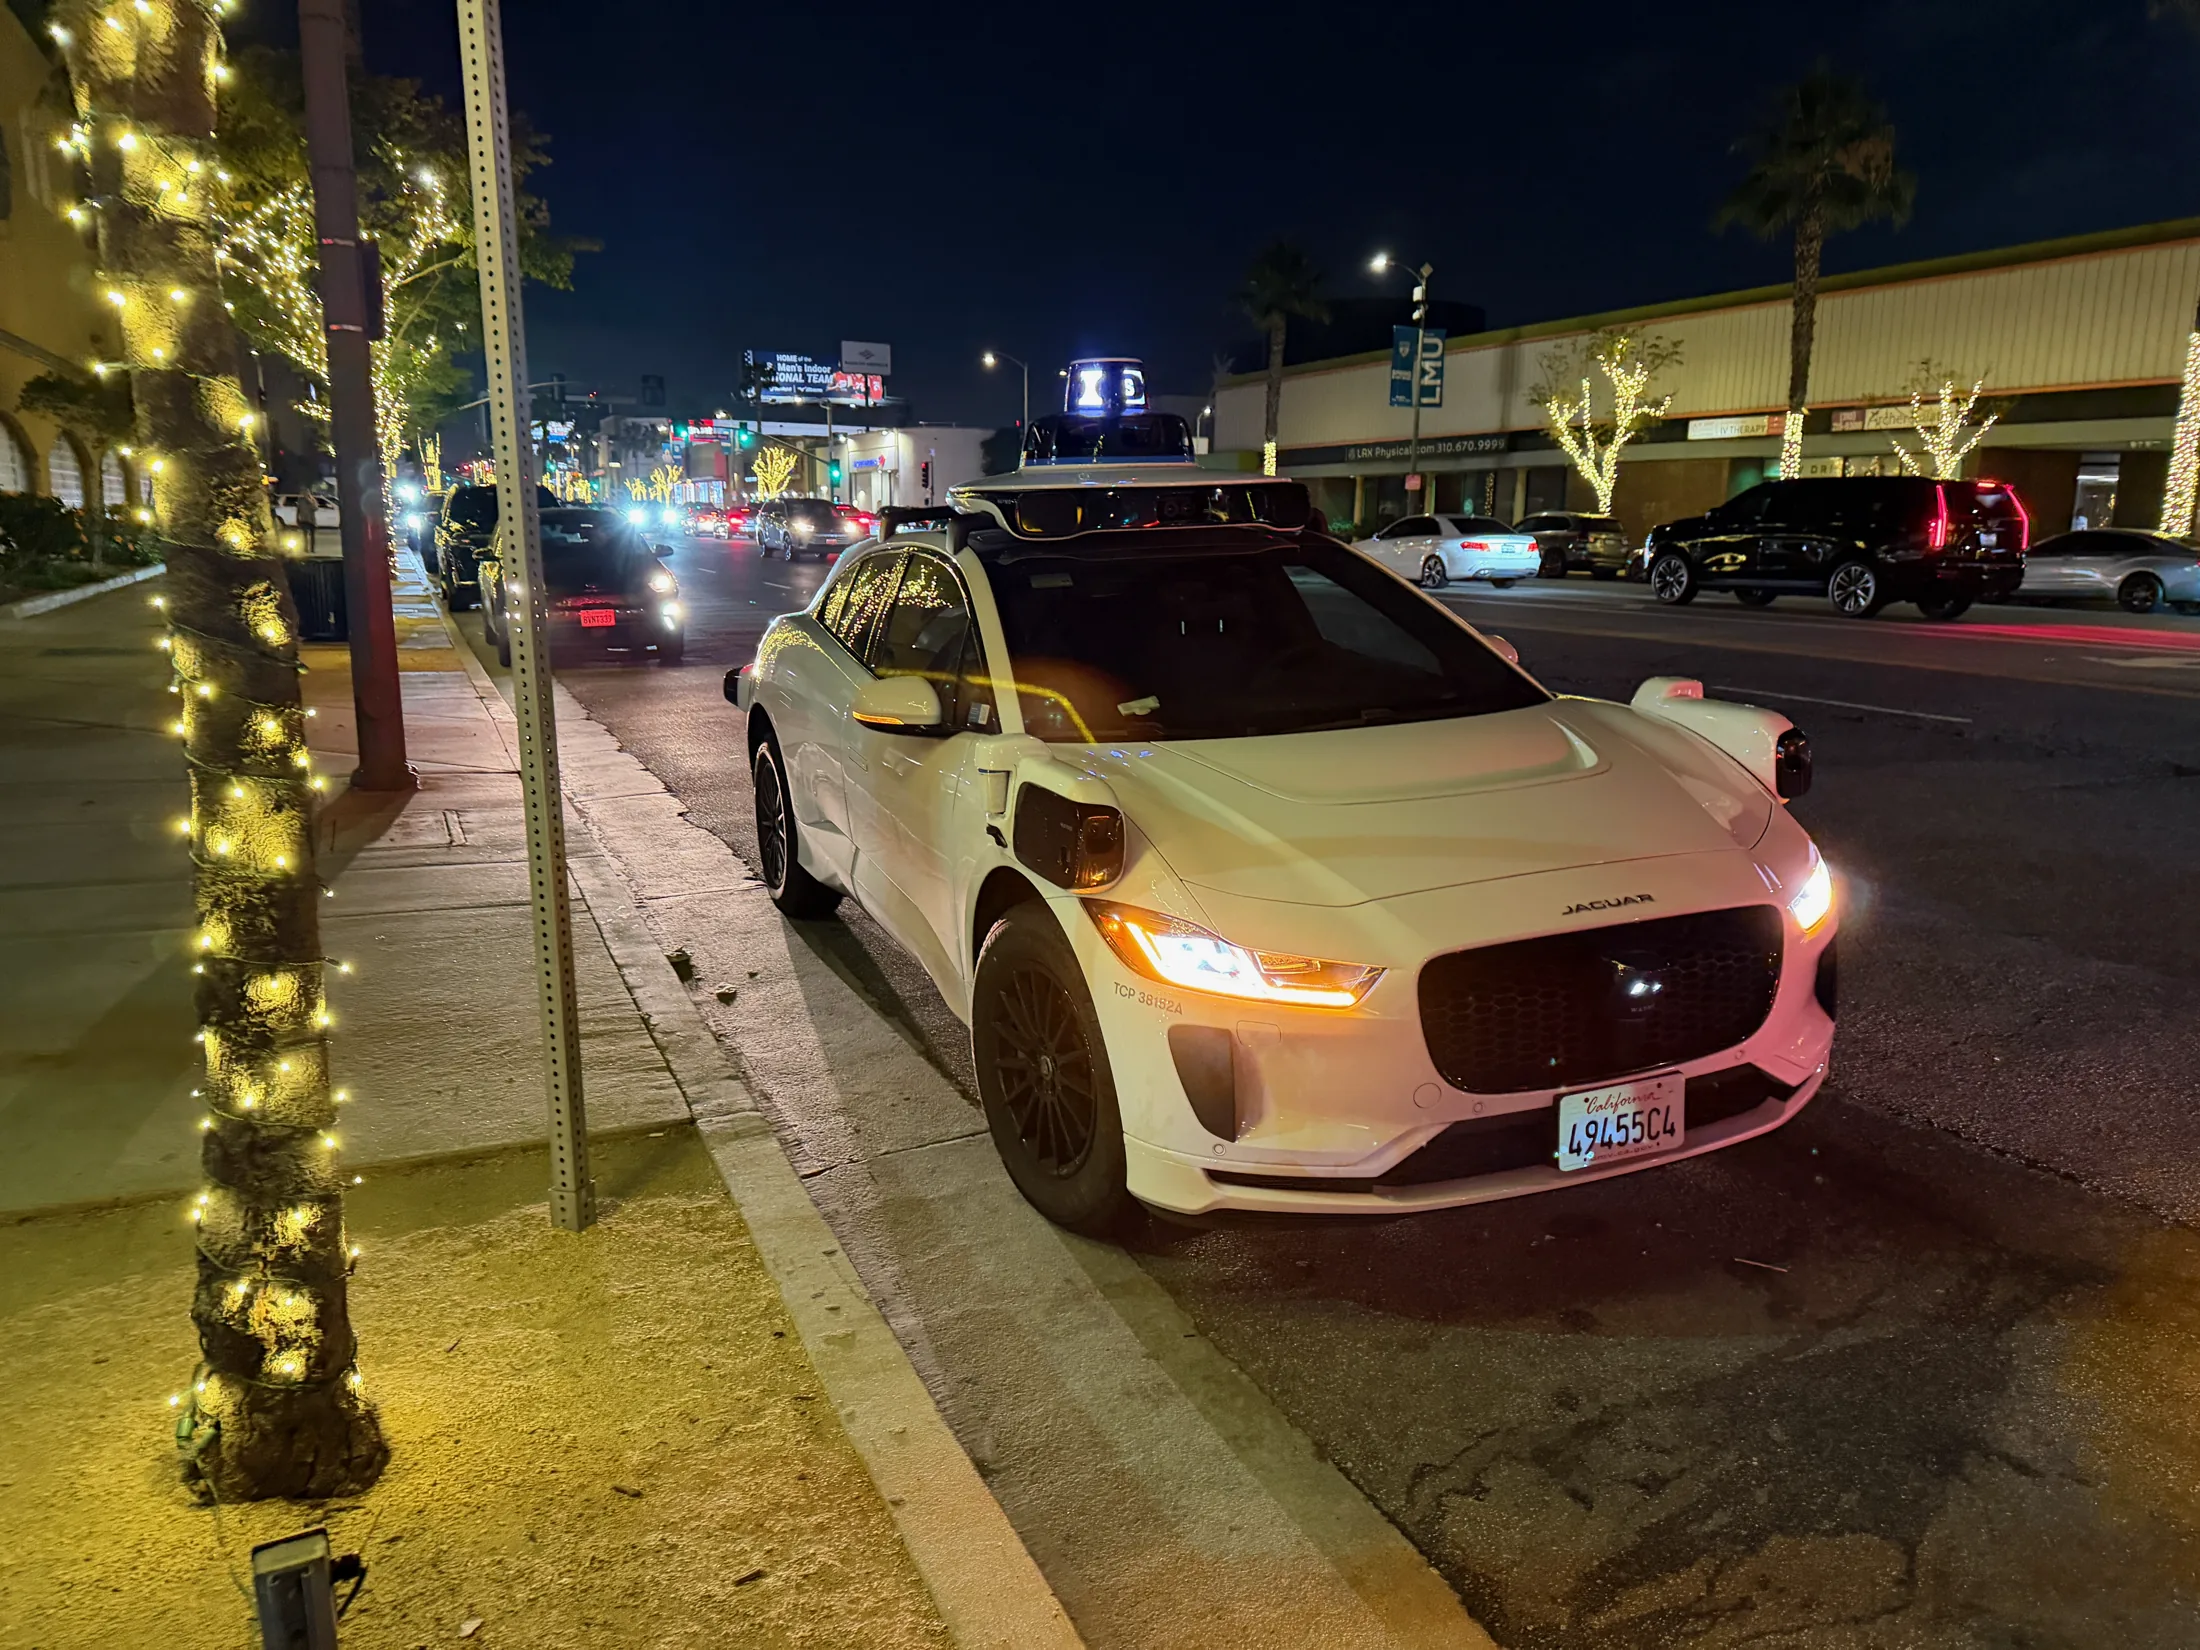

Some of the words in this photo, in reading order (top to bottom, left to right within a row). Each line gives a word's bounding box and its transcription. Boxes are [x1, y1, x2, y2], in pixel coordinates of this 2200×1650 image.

[776, 354, 798, 363] HOME
[777, 363, 803, 373] Men's
[804, 364, 832, 374] Indoor
[806, 373, 834, 384] TEAM
[1420, 337, 1444, 404] LMU
[1730, 424, 1766, 435] THERAPY
[1357, 448, 1373, 459] LAX
[1436, 439, 1505, 454] 310.670.9999
[1562, 893, 1655, 916] JAGUAR
[1113, 981, 1136, 1000] TCP
[1138, 991, 1183, 1015] 38152A
[1586, 1091, 1663, 1115] California
[1568, 1105, 1676, 1158] 49455C4
